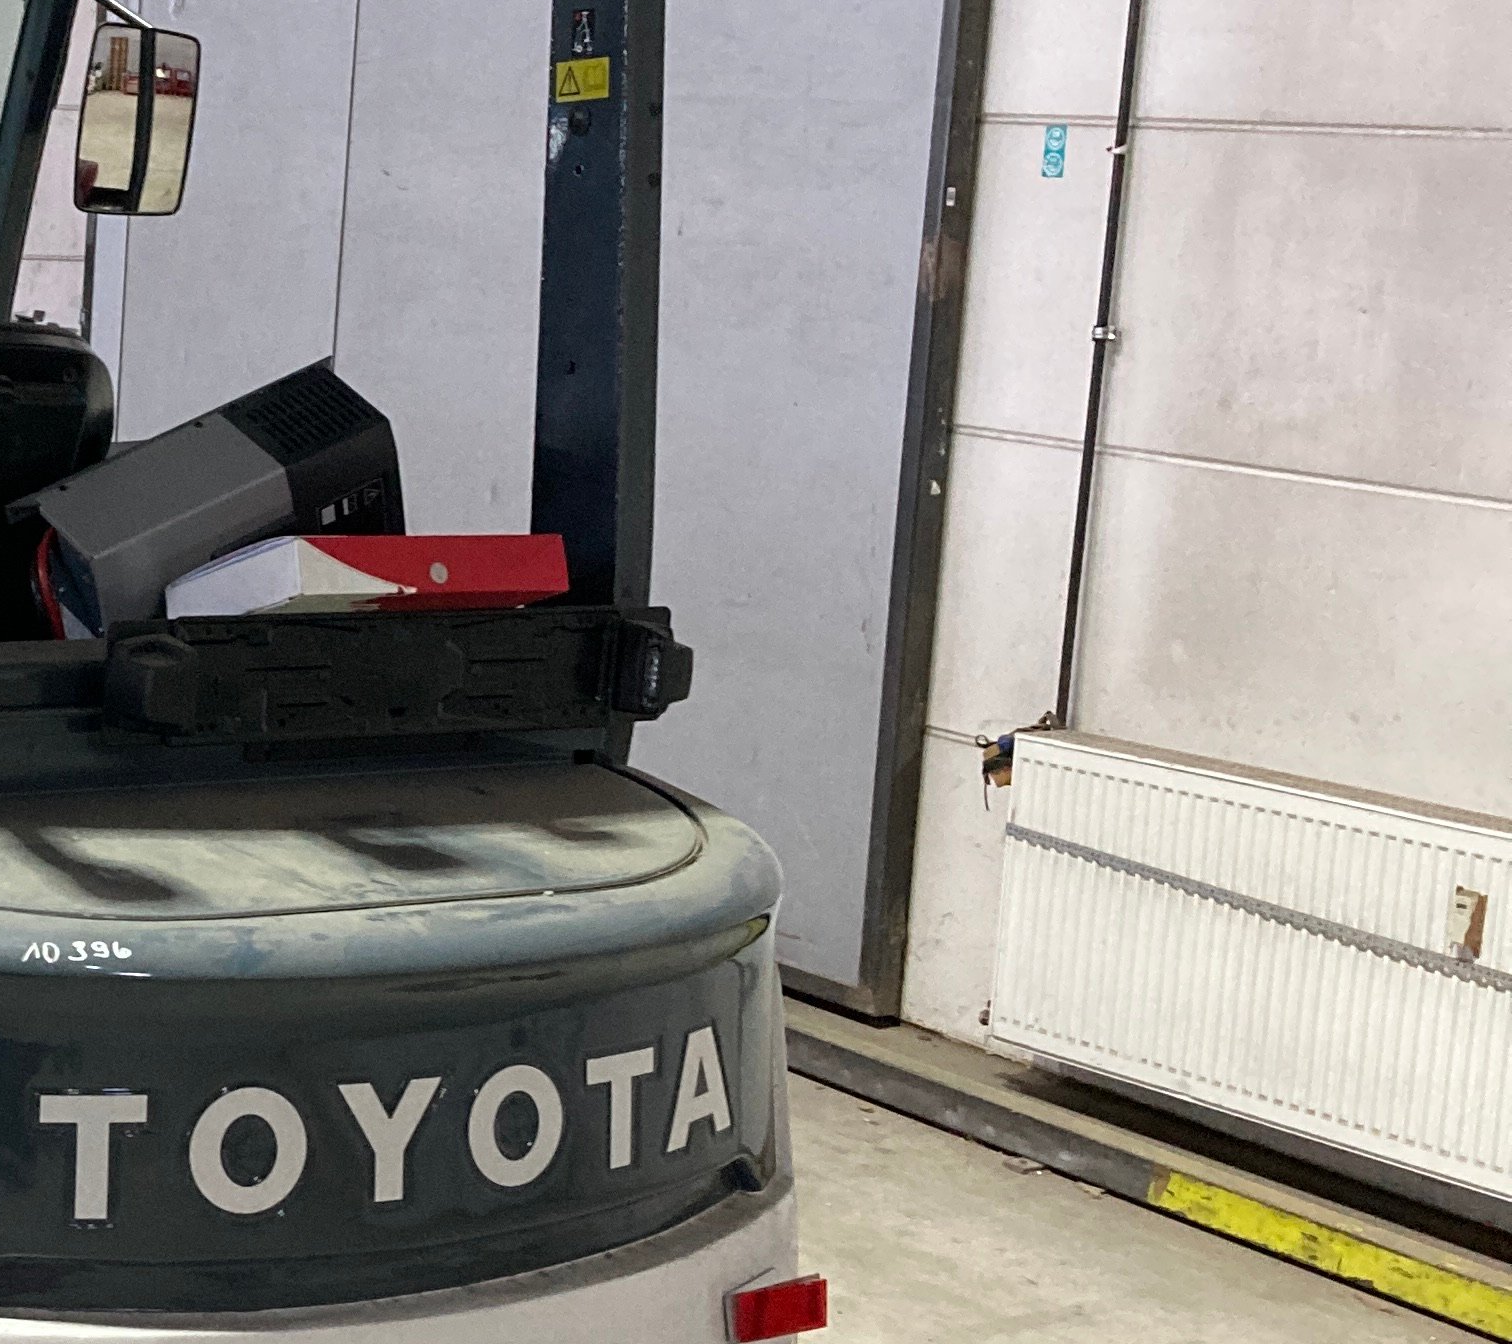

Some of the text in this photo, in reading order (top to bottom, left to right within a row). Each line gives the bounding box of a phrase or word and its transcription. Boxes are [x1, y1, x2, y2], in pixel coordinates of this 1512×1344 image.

[21, 940, 133, 964] 10 396
[39, 1025, 731, 1220] TOYOTA
